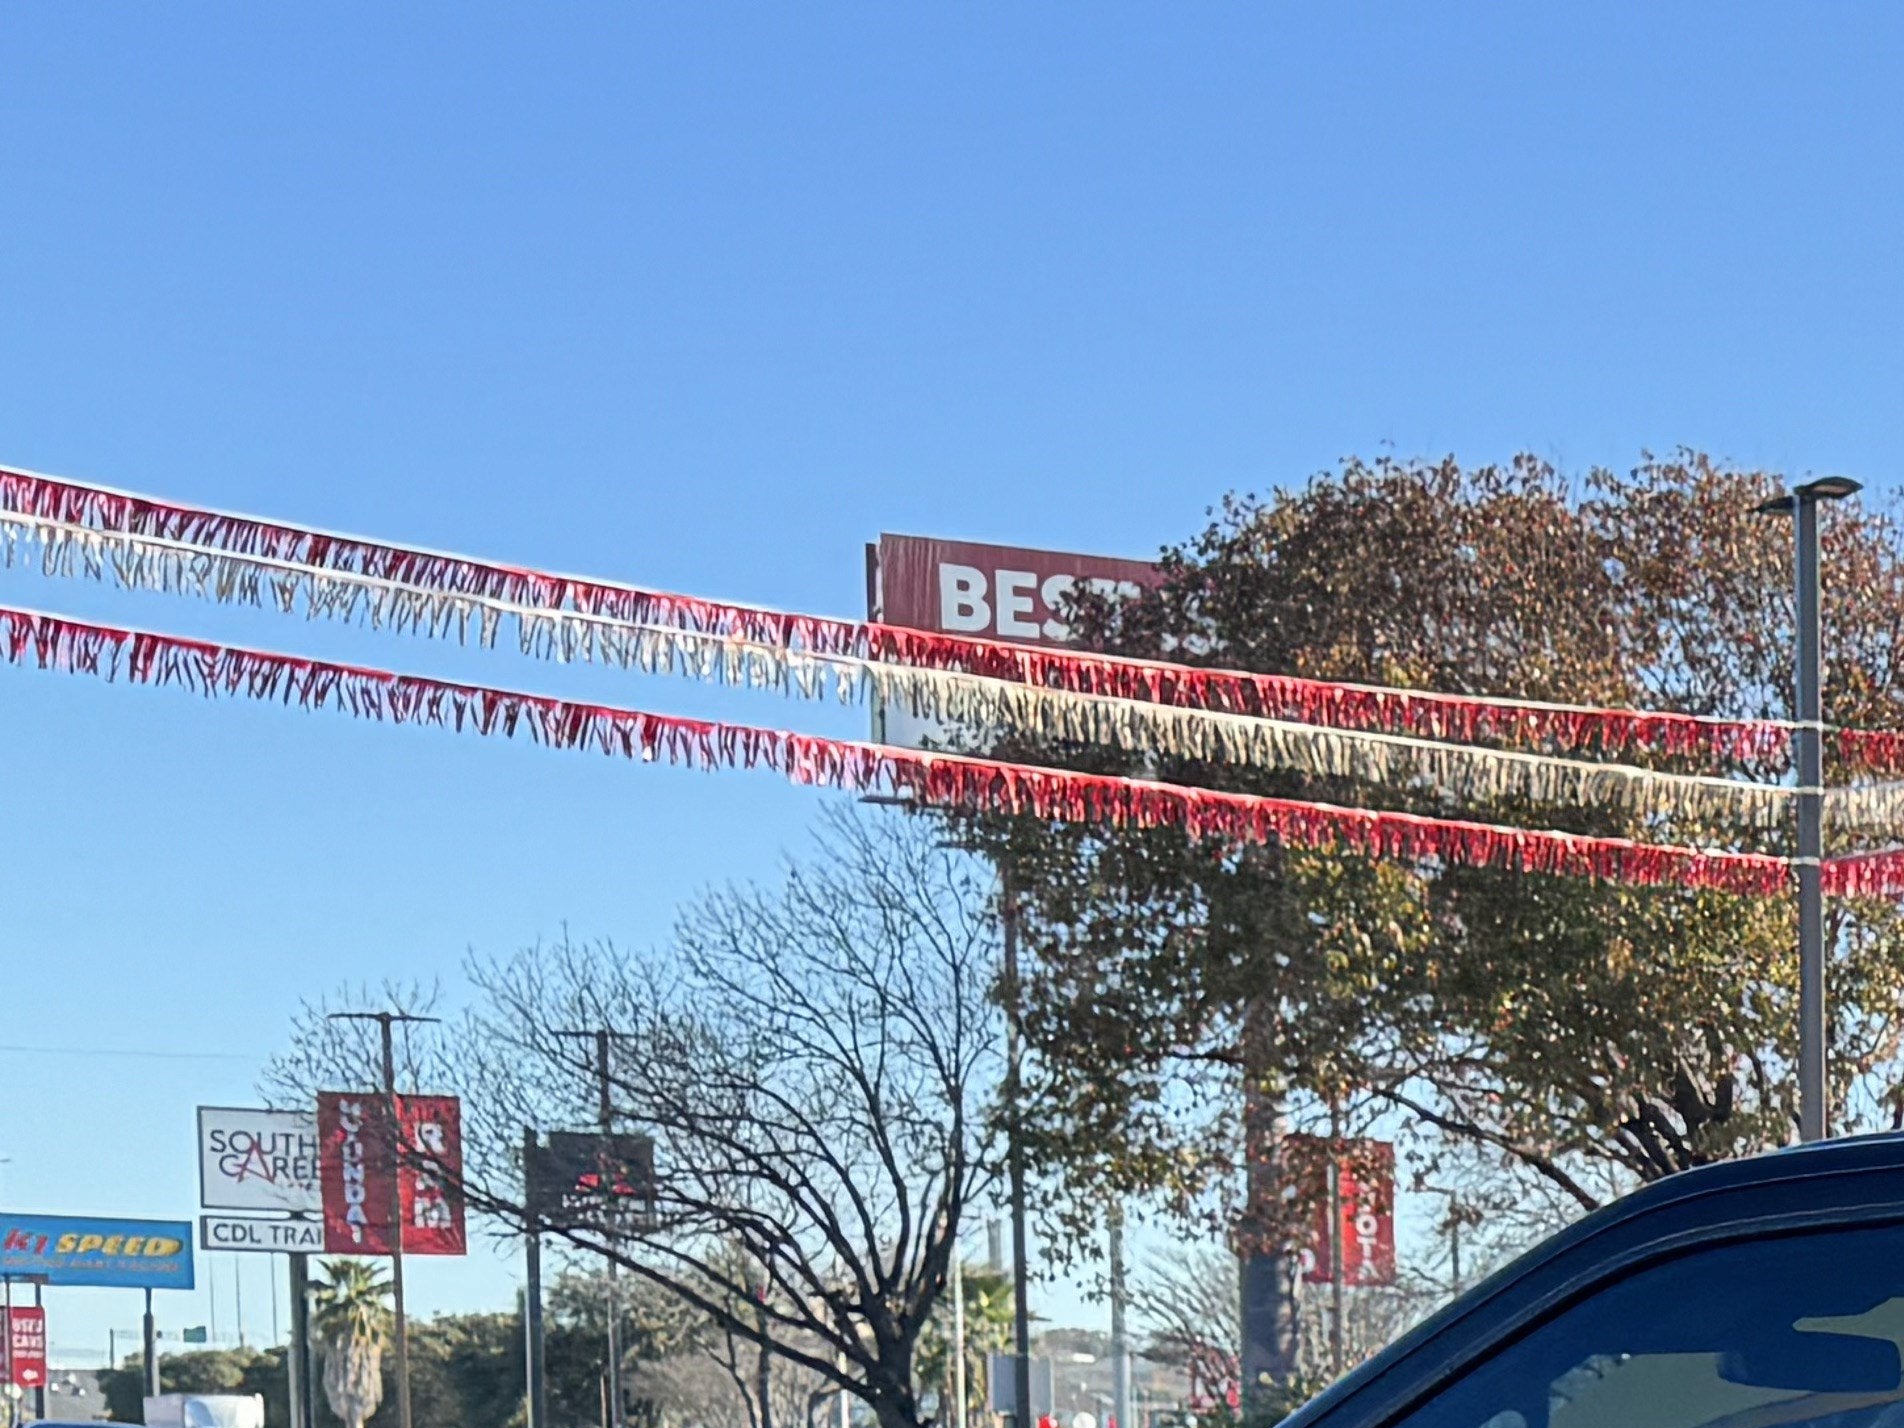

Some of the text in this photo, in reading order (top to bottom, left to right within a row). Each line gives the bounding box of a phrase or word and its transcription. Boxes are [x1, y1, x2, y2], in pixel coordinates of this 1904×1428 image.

[210, 1129, 317, 1157] SOUTH
[56, 1233, 183, 1257] SPEED
[213, 1223, 262, 1243] CDL
